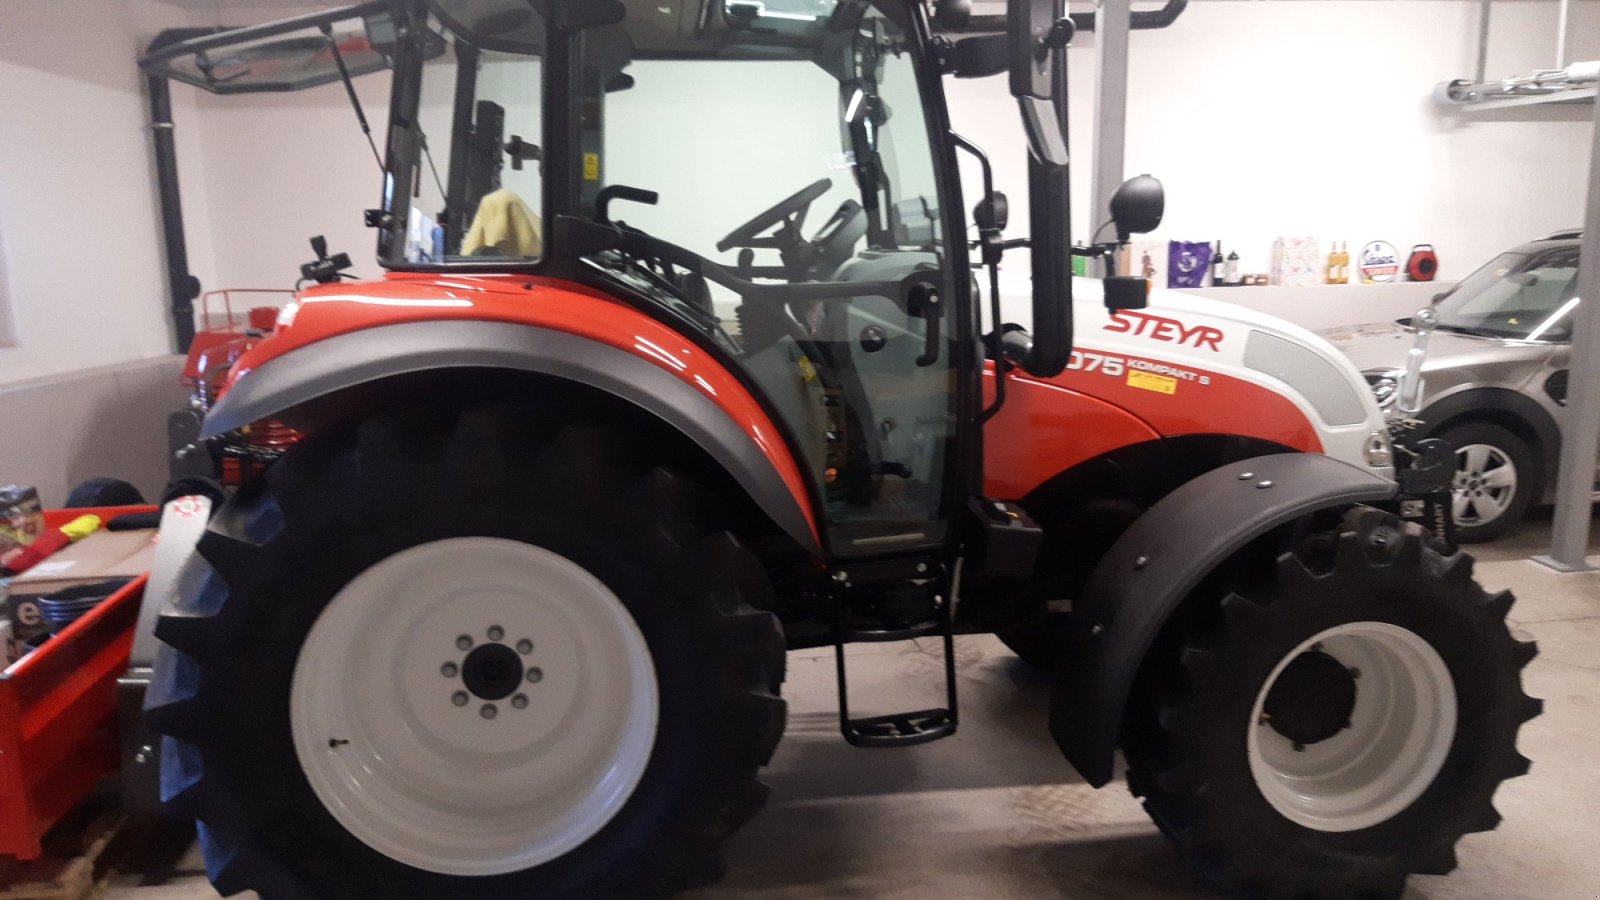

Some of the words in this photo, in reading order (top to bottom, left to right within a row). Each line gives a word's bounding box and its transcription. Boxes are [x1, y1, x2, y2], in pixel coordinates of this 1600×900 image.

[1103, 309, 1224, 352] STEYR
[1127, 358, 1198, 381] KOMPAKT
[1198, 375, 1211, 385] S
